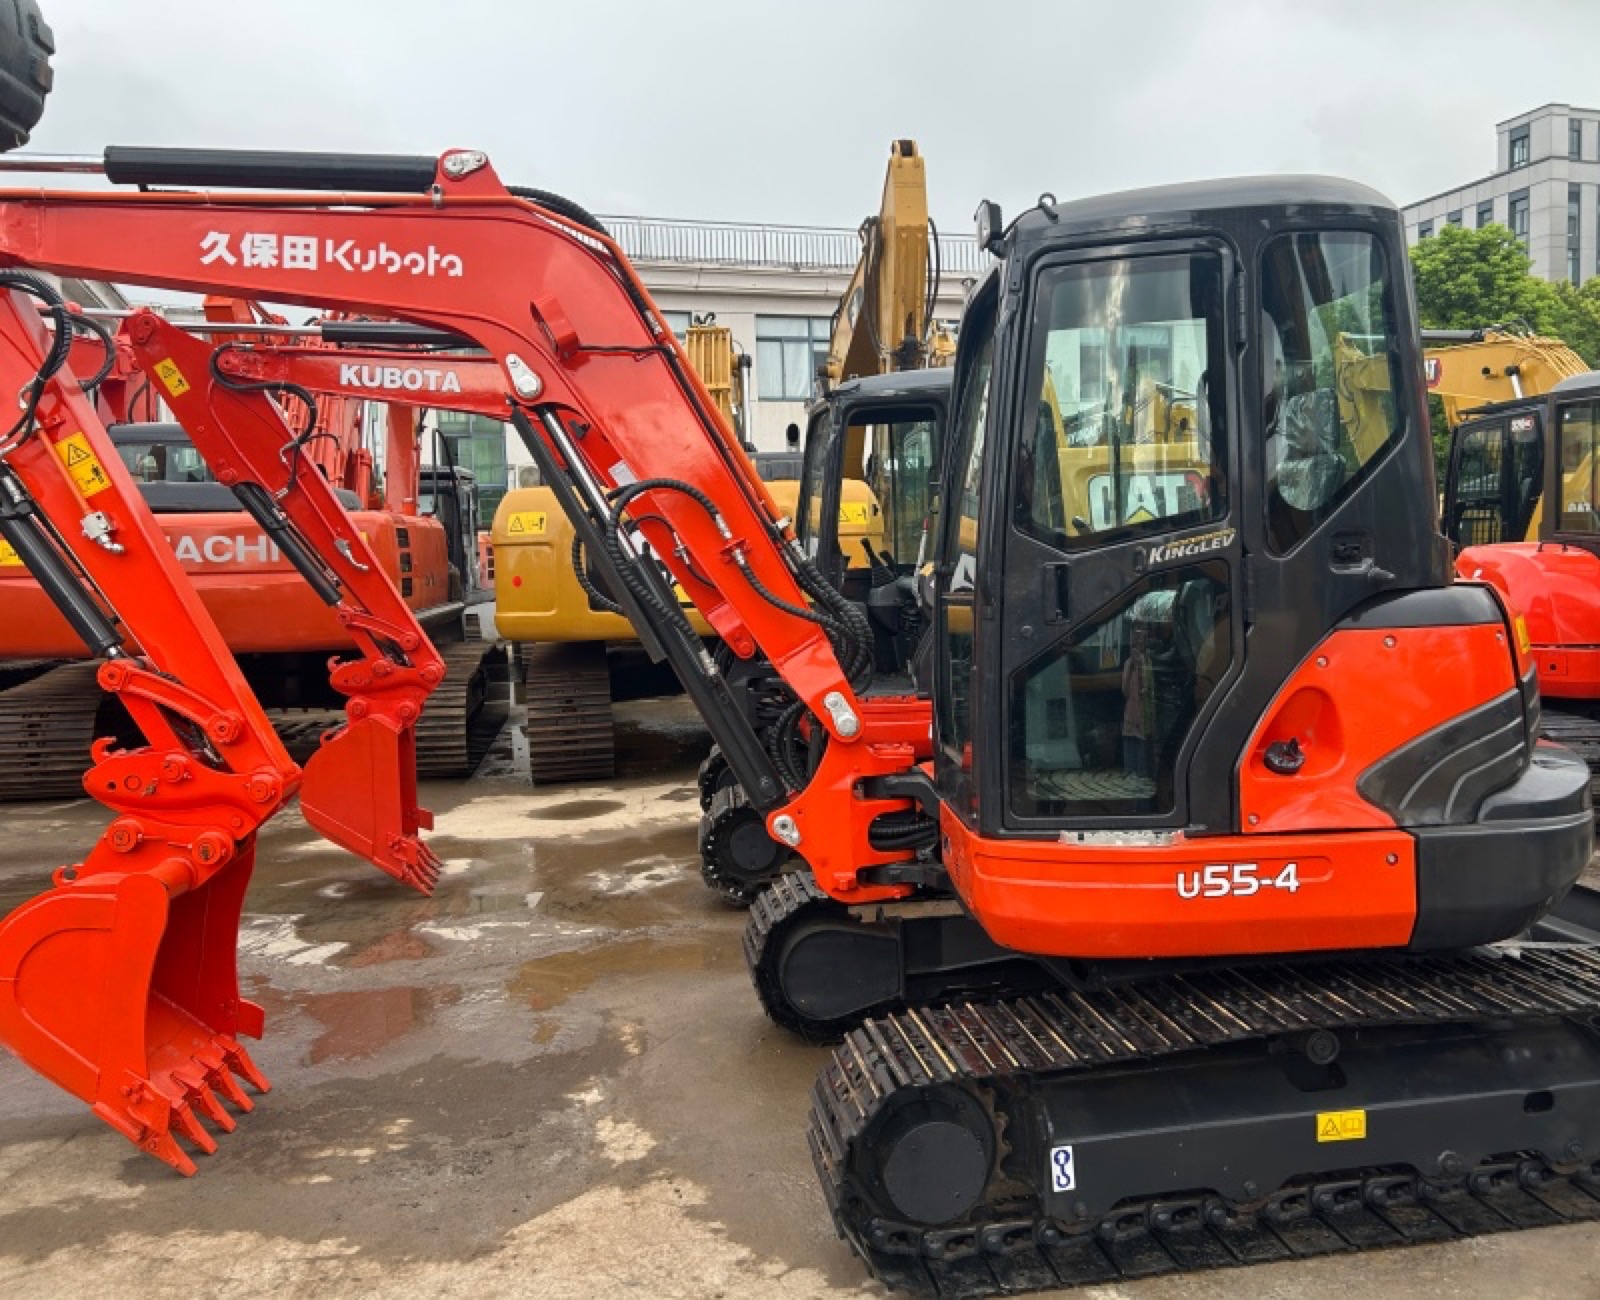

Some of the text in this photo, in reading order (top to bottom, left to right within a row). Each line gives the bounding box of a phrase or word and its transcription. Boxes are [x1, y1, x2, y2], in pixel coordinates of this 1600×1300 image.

[200, 231, 463, 276] 久保田 Kubota
[340, 364, 461, 392] KUBOTA
[1090, 475, 1185, 531] CAT
[166, 535, 279, 562] ACHI
